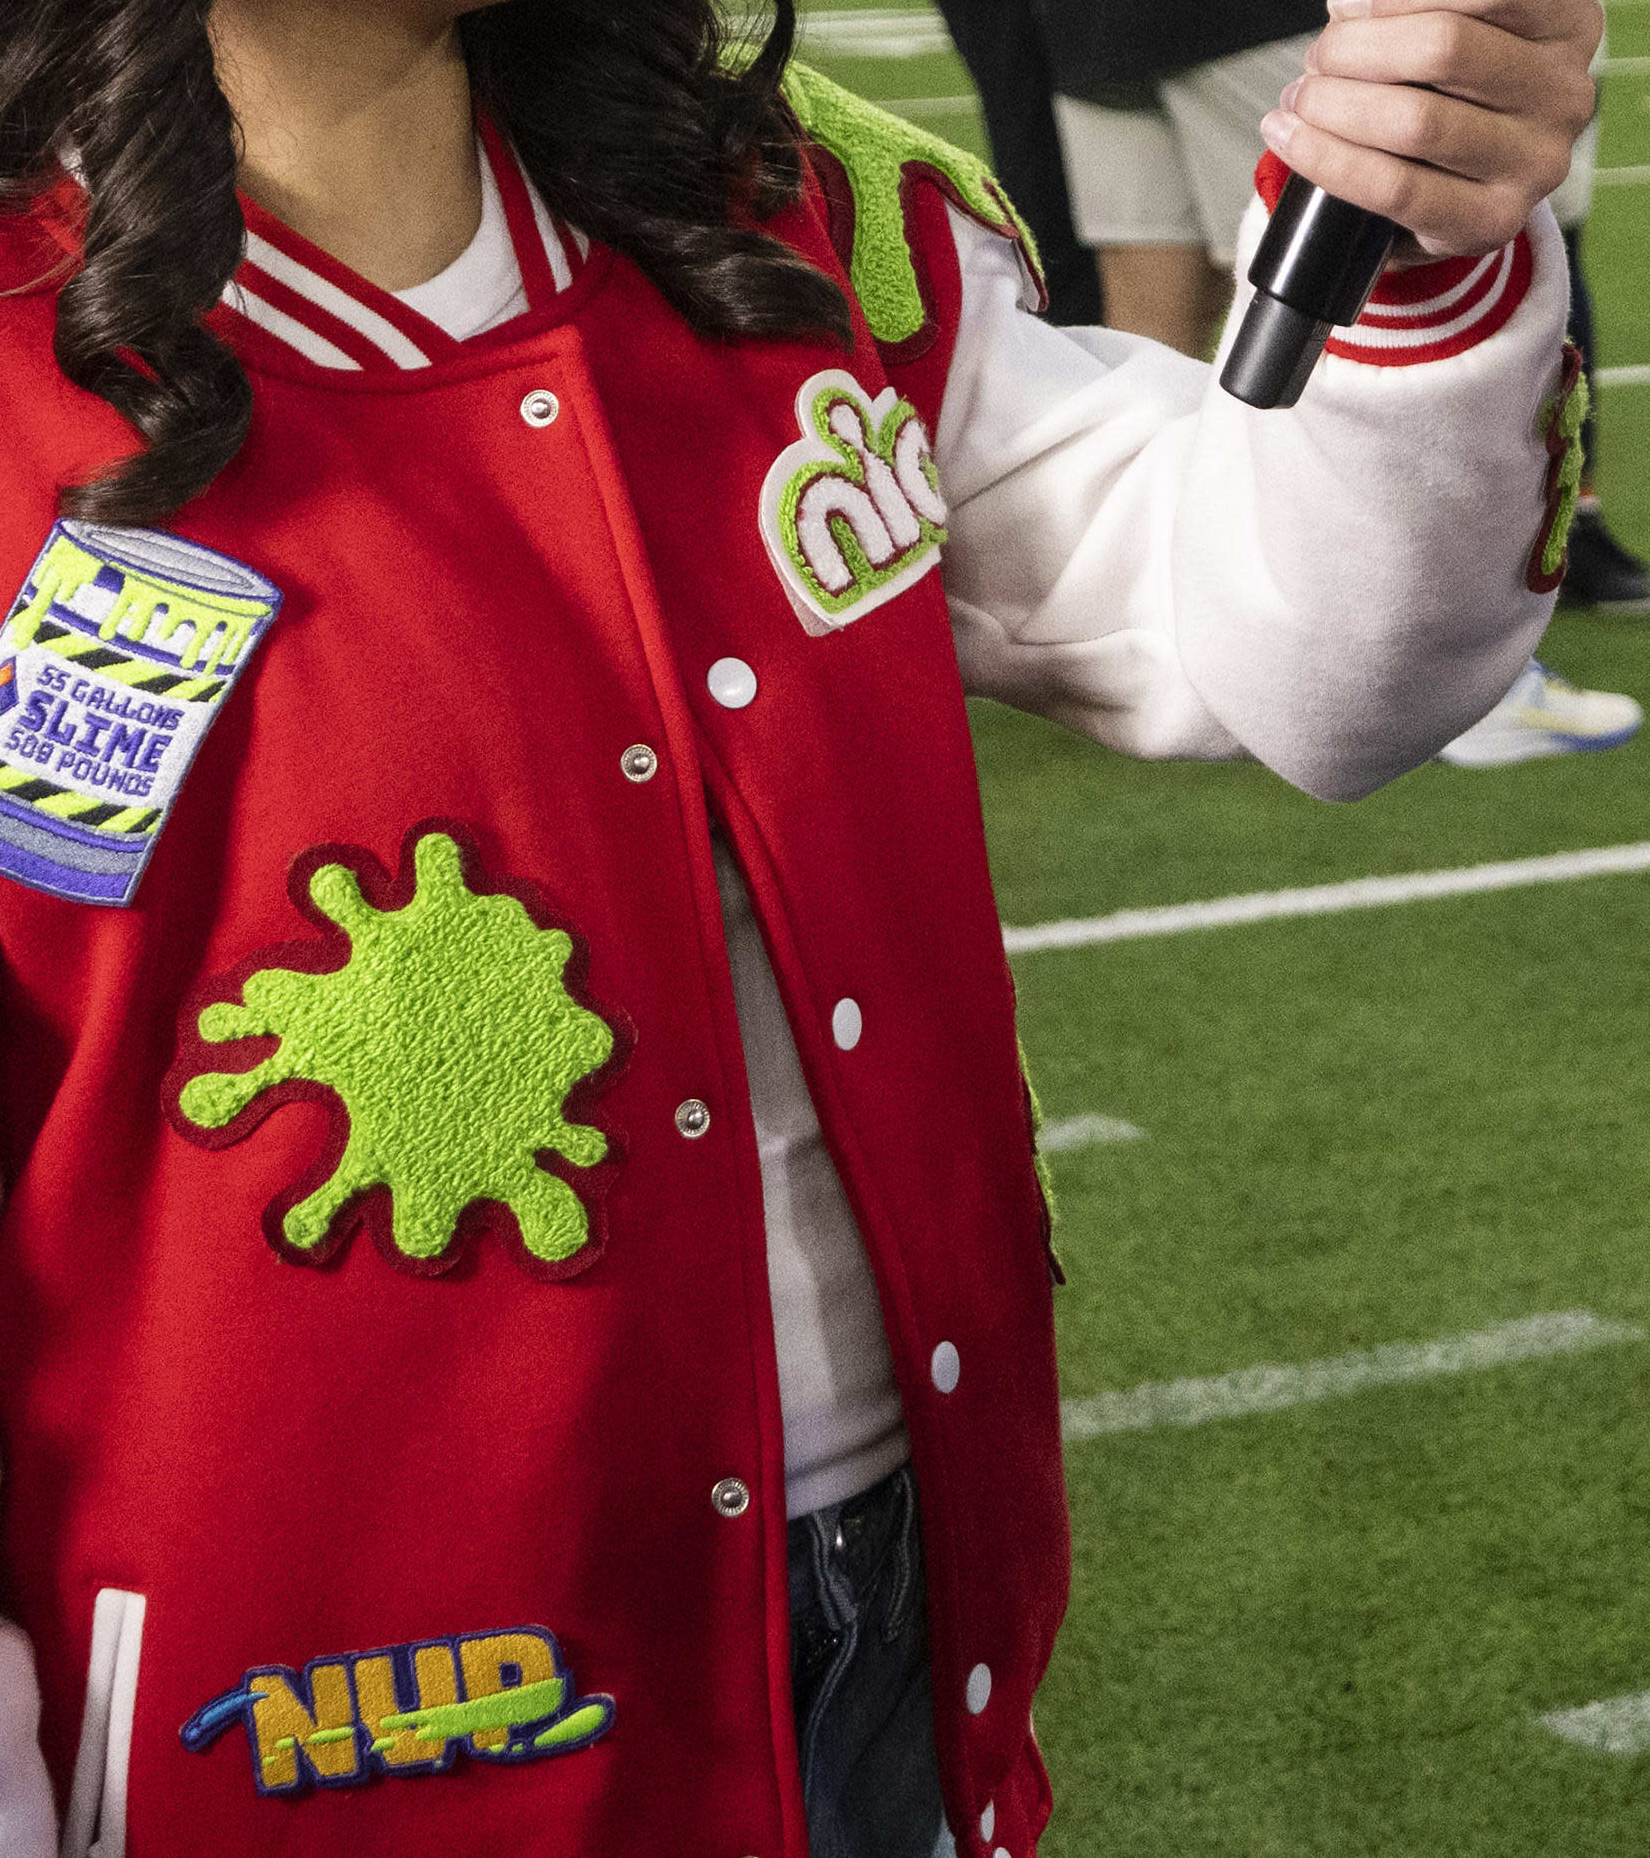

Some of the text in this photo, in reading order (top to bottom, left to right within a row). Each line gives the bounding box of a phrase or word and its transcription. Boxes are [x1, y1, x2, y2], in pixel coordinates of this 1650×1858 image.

[37, 664, 185, 731] 55 GALLONS
[18, 689, 173, 774] SLIME
[56, 750, 156, 797] POUNDS
